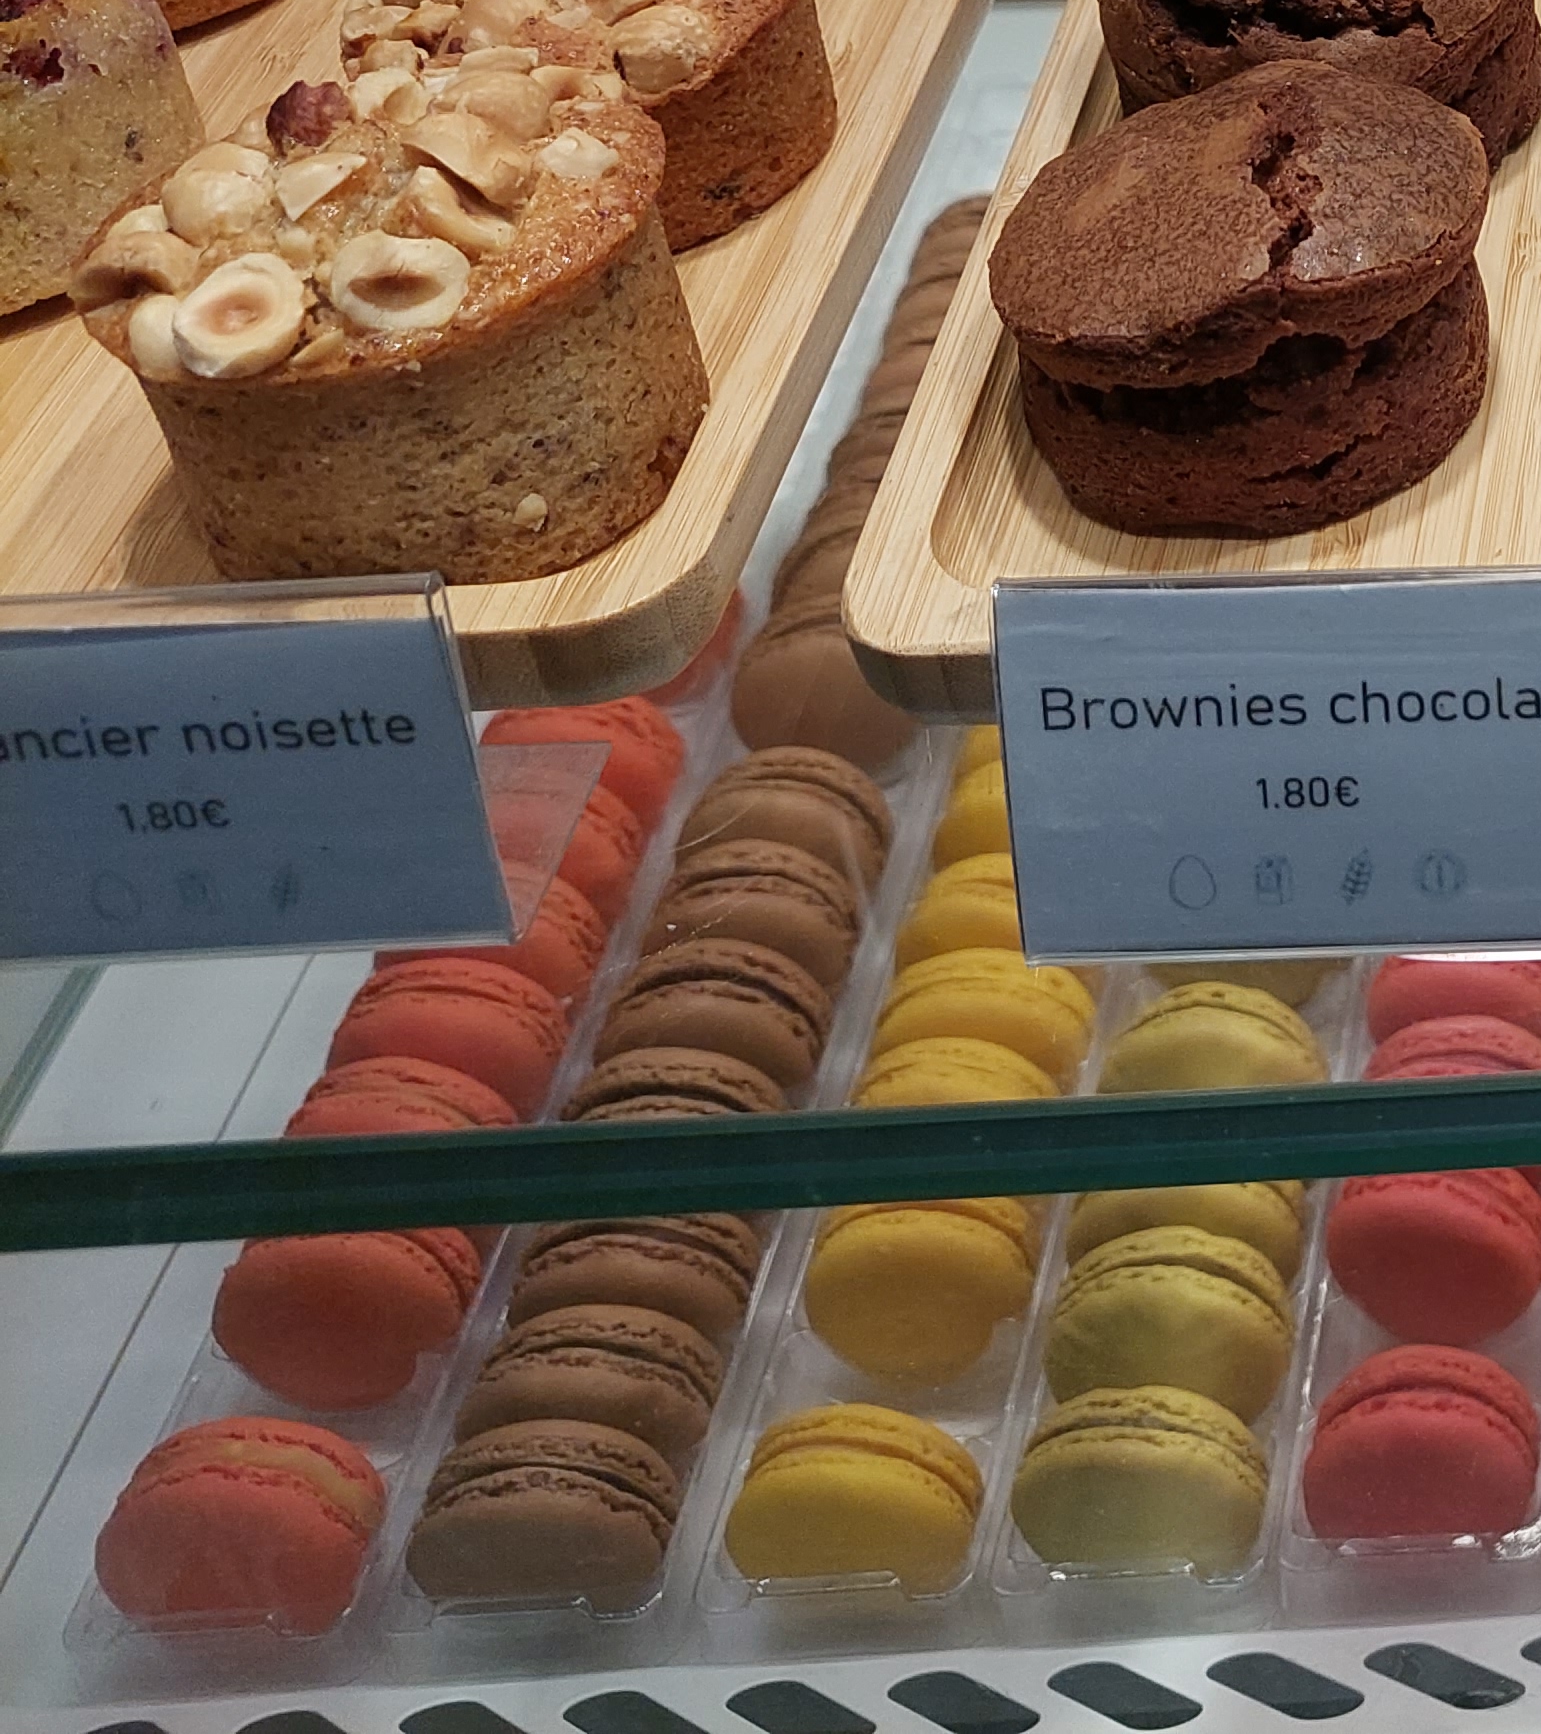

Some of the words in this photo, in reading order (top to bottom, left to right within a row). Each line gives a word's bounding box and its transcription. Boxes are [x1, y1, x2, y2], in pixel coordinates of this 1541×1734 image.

[1040, 683, 1309, 731] Brownies
[0, 716, 161, 761] ncier
[182, 709, 418, 756] noisette
[1254, 775, 1361, 810] 1.80€
